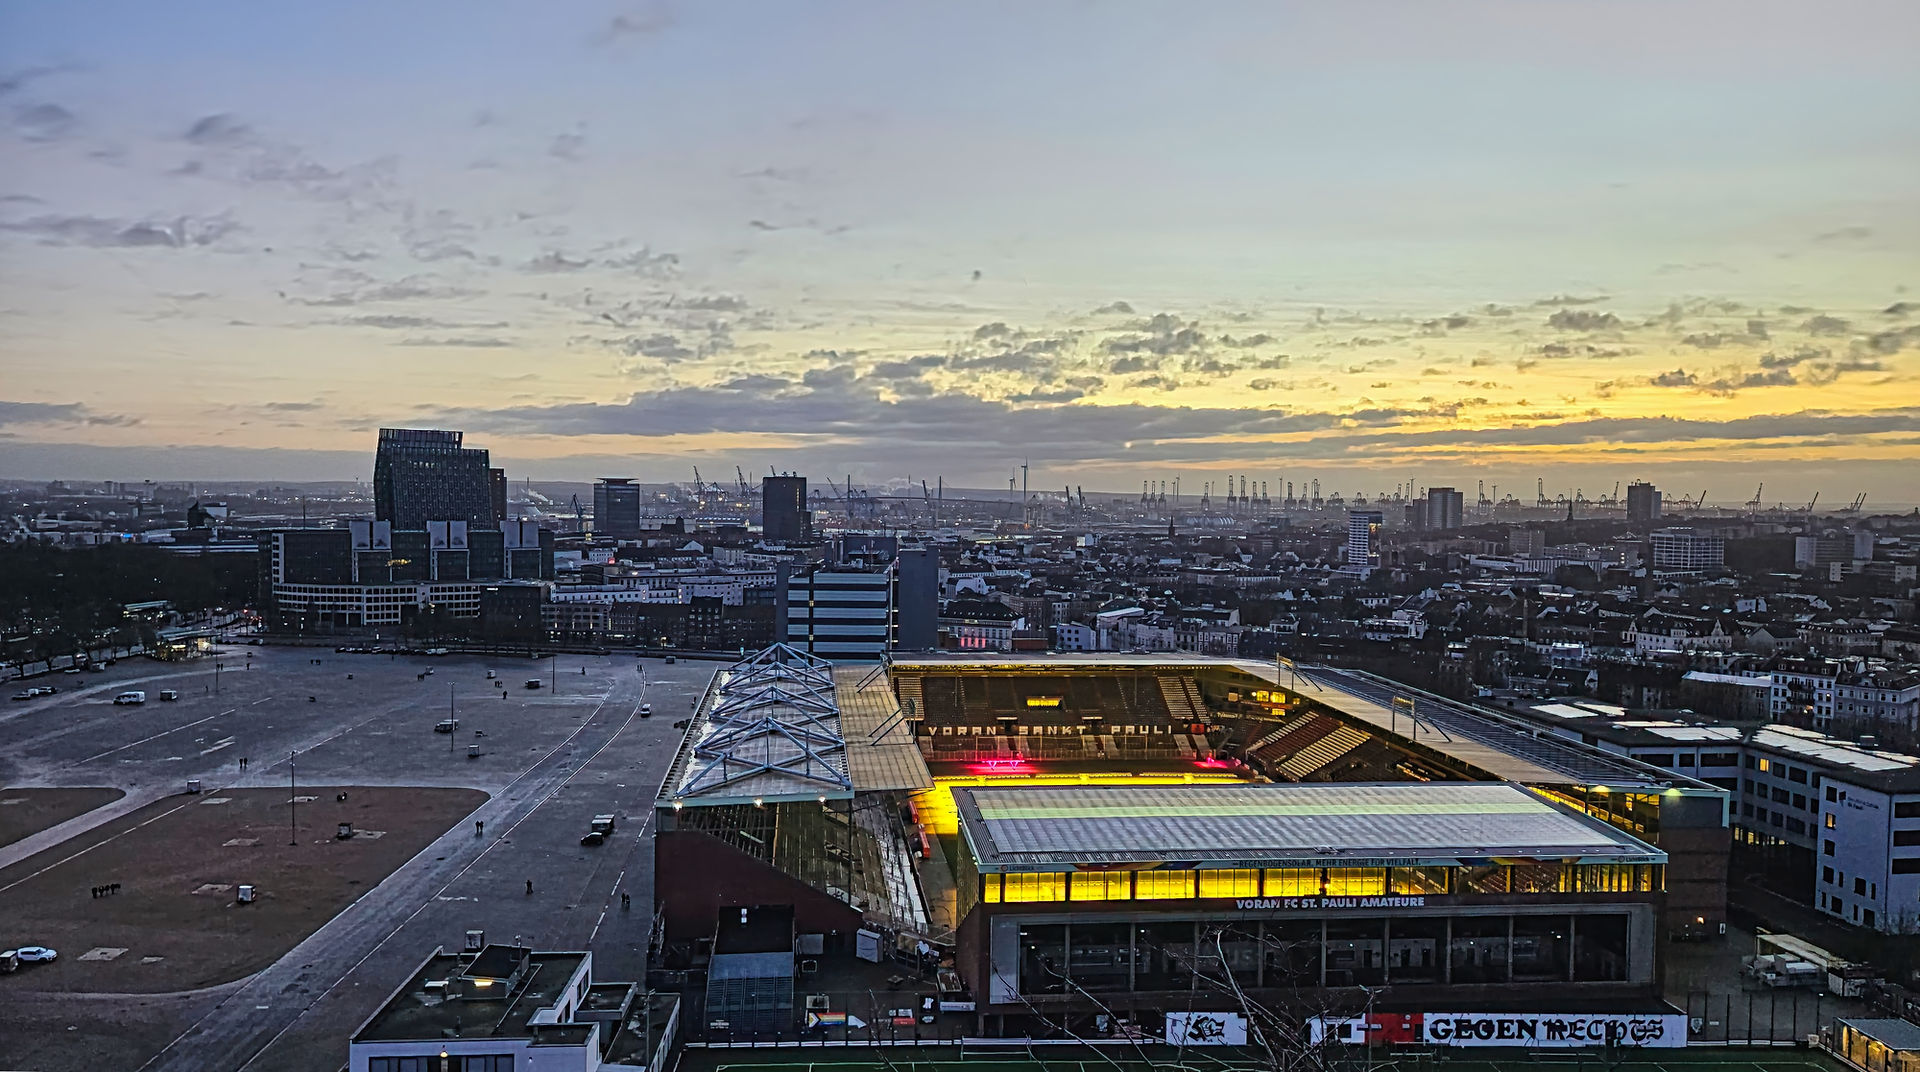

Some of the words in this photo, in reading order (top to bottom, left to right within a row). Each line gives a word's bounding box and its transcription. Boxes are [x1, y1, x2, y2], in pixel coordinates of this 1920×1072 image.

[928, 726, 997, 736] VORAN
[1018, 725, 1086, 735] SANKT
[1111, 725, 1172, 735] PAULI
[1236, 899, 1280, 909] VORAN
[1284, 898, 1298, 908] FC
[1301, 898, 1318, 908] ST.
[1321, 898, 1357, 908] PAULI
[1360, 897, 1425, 907] AMATEURE
[1429, 1018, 1539, 1040] GEGEN
